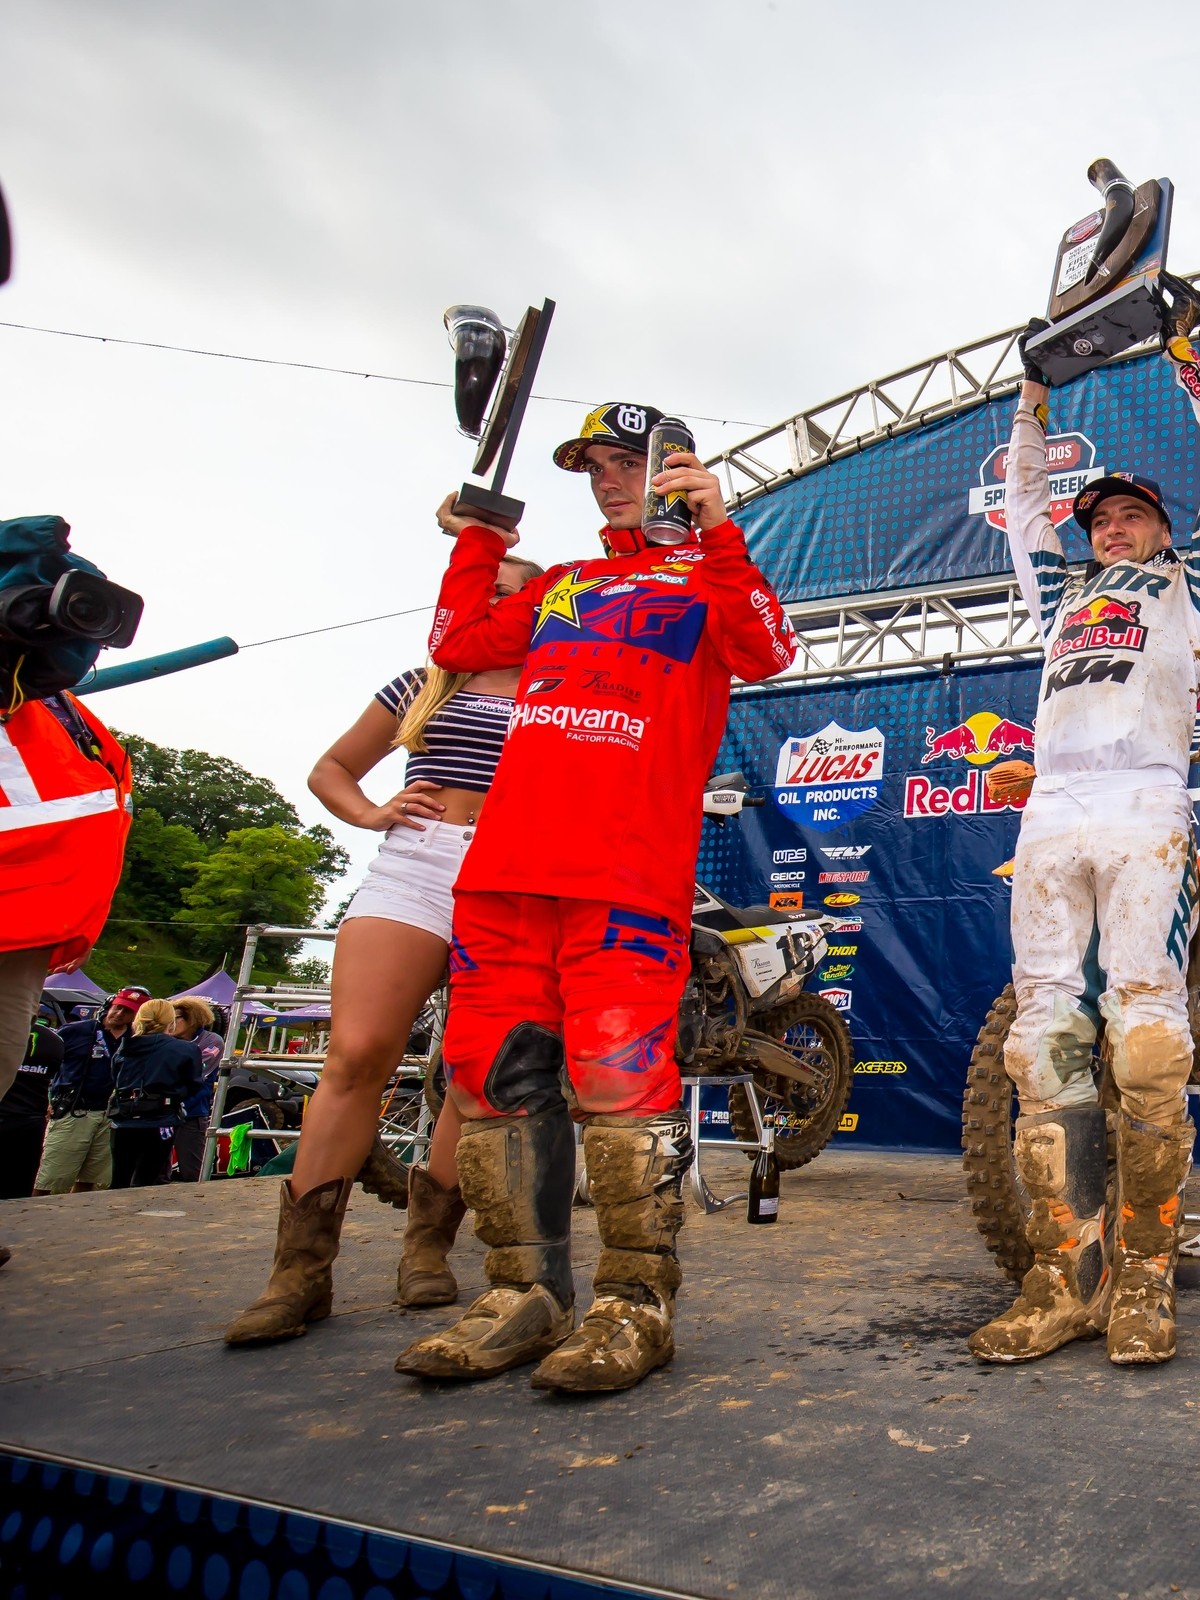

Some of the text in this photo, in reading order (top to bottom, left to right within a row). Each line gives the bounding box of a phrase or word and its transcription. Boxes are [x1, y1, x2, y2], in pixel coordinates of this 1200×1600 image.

[1052, 627, 1142, 657] Red Bull
[1043, 654, 1135, 702] KTM
[515, 703, 645, 739] Husqvarna
[566, 733, 640, 751] FACTORY RACING
[834, 742, 882, 752] PERFORMANCE
[789, 752, 880, 784] LUCAS
[778, 786, 878, 804] OIL PRODUCTS
[908, 770, 978, 817] Red
[813, 807, 841, 821] INC.
[773, 848, 806, 864] WPS
[770, 871, 806, 881] GEICO
[824, 895, 860, 906] FMF
[827, 946, 858, 956] THOR
[822, 971, 848, 981] Tender
[828, 964, 851, 973] Battery
[711, 1110, 730, 1120] PRO
